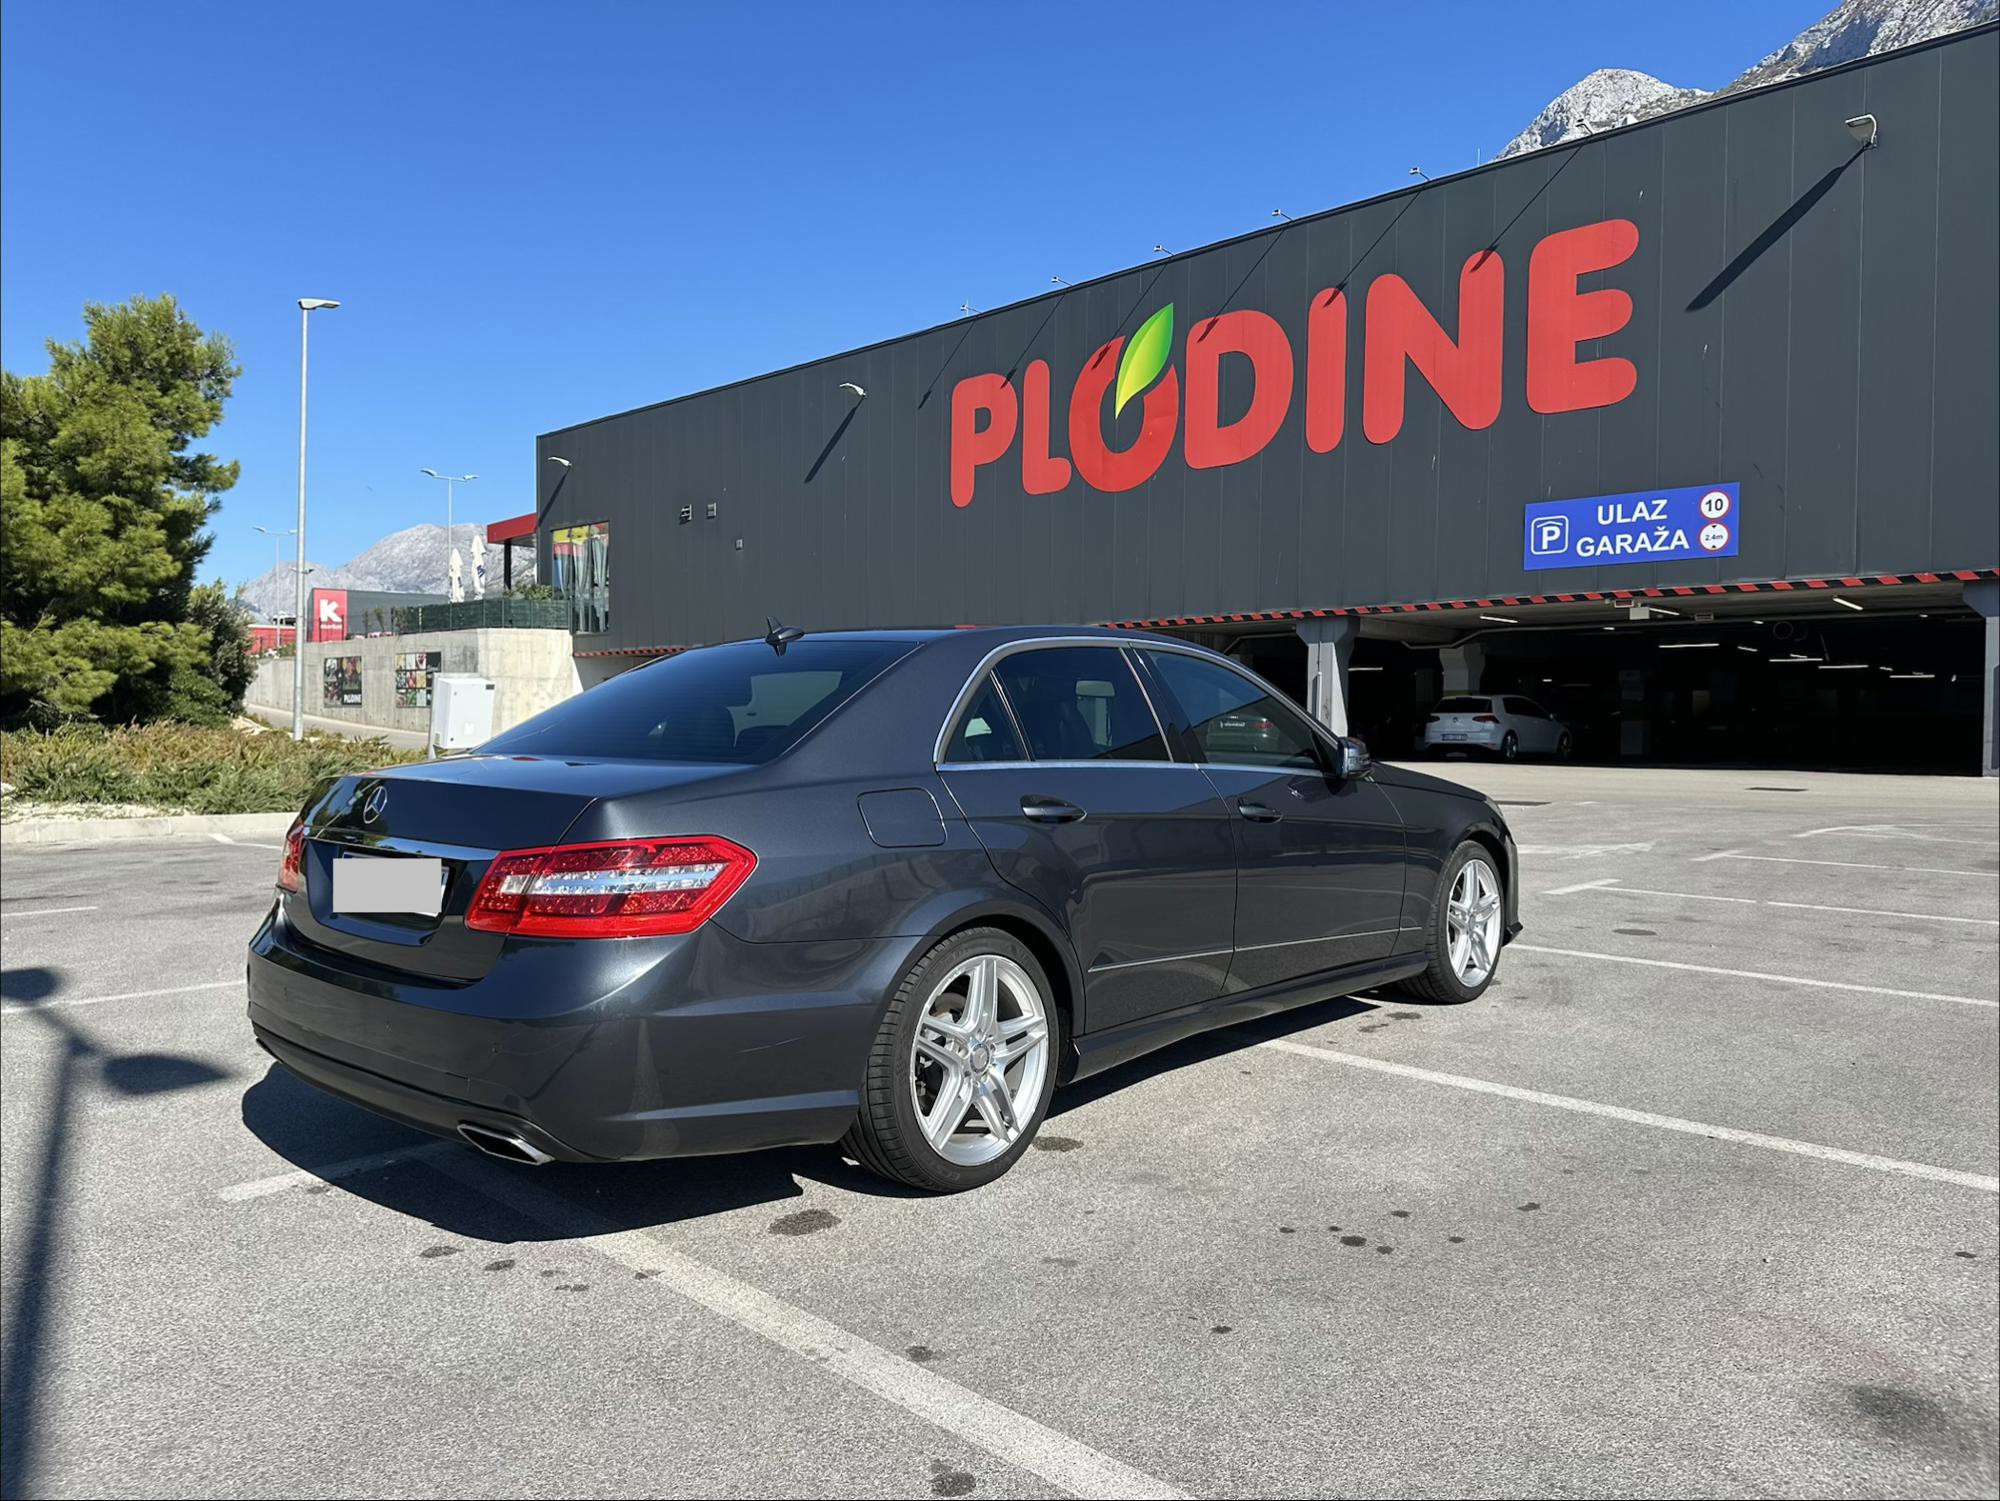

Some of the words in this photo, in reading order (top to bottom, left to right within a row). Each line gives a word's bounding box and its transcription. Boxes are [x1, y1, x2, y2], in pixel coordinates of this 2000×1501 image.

[949, 218, 1640, 508] PLODINE
[1597, 499, 1668, 526] ULAZ
[1704, 498, 1724, 512] 10
[1541, 526, 1561, 550] P
[1576, 526, 1690, 557] GARAŽA
[319, 599, 343, 622] K
